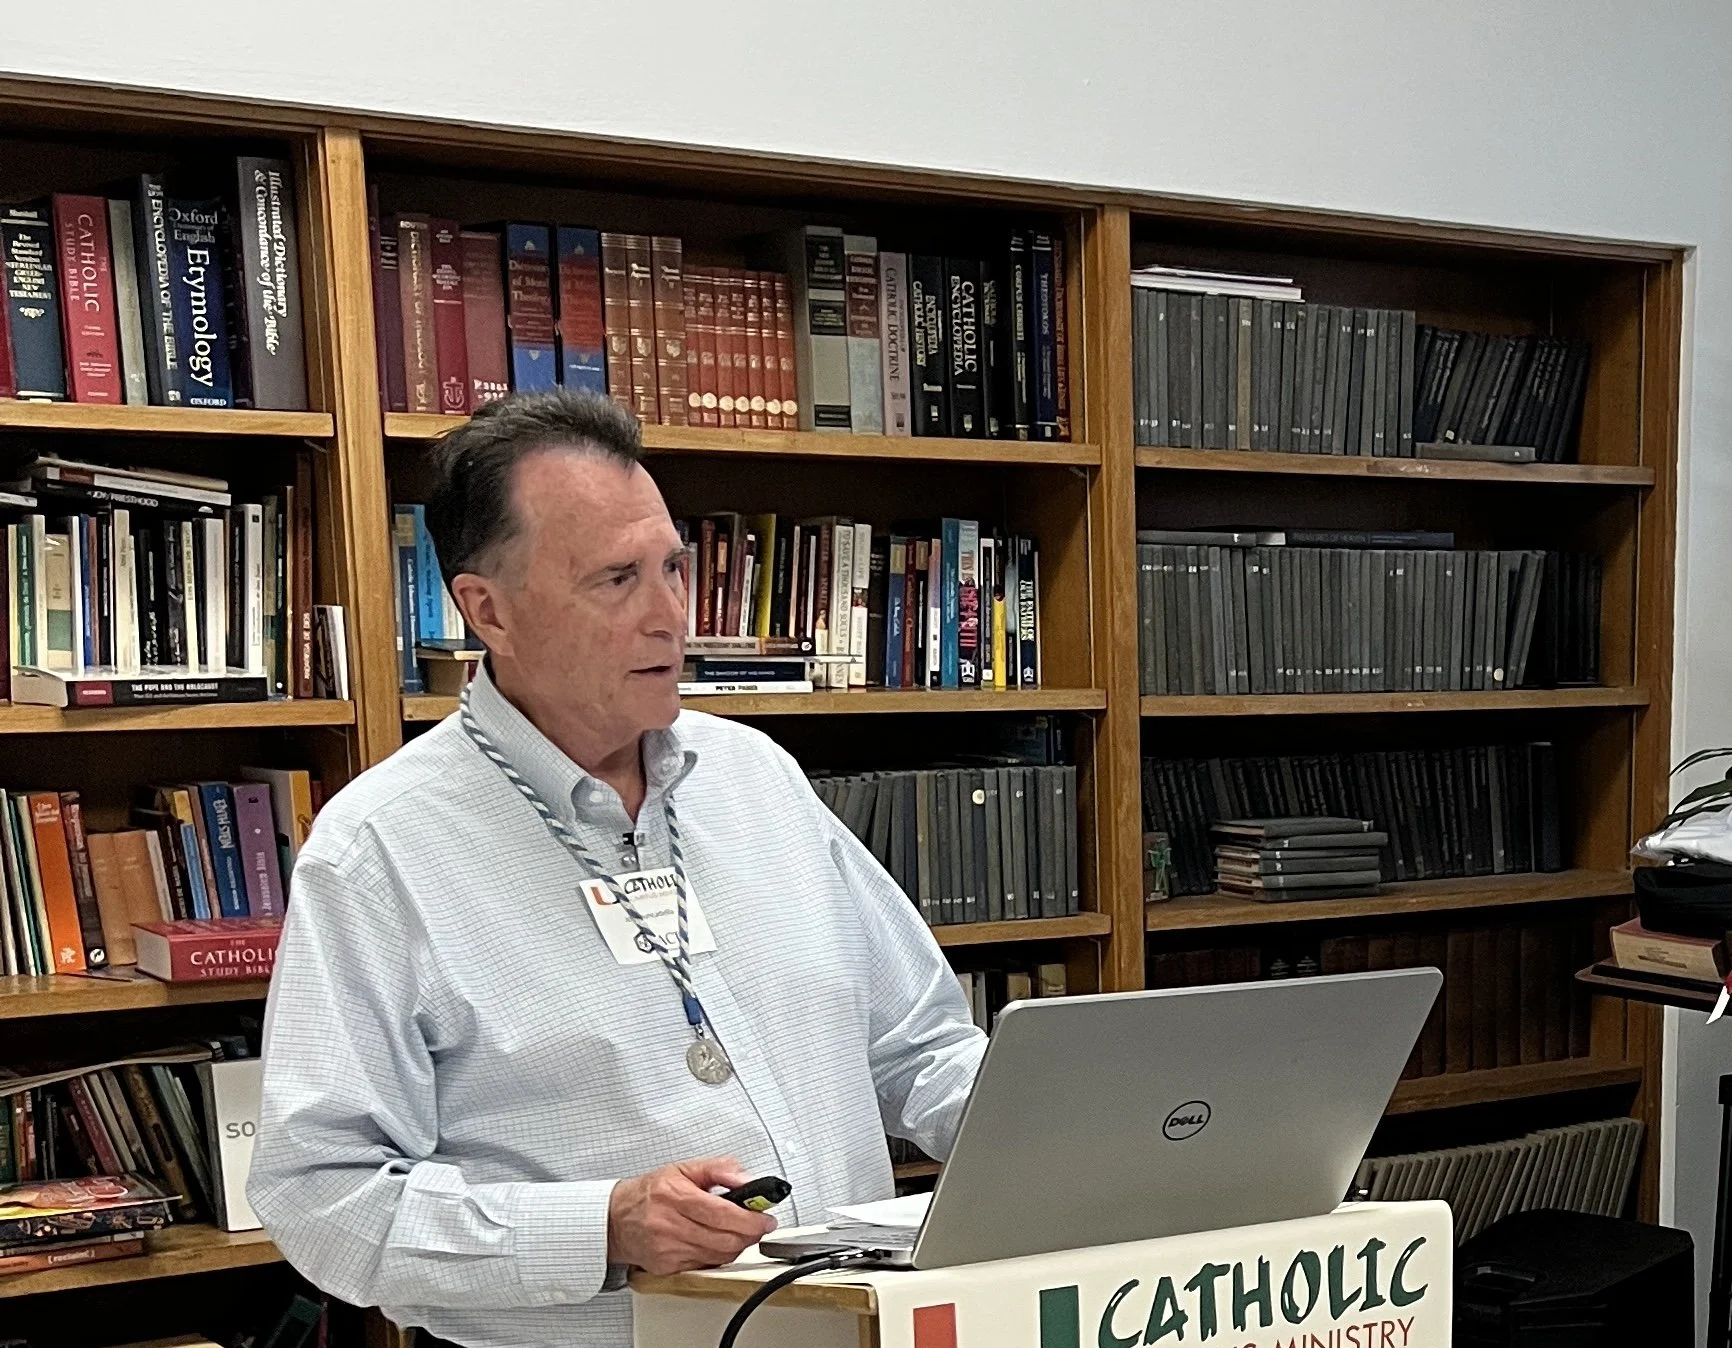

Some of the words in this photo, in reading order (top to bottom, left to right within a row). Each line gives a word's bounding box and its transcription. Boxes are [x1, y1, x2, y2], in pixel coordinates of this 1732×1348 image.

[169, 207, 218, 225] Oxford
[268, 170, 286, 241] Illustrated
[65, 223, 77, 267] STUDY
[152, 199, 170, 290] ENCYCLOPEDIA
[174, 229, 216, 244] English
[255, 186, 273, 272] Concordance
[78, 213, 100, 312] CATHOLIC
[257, 272, 277, 289] of
[274, 241, 288, 317] Dictionary
[68, 268, 80, 302] BIBLE
[160, 290, 172, 308] OF
[262, 289, 277, 315] the
[885, 267, 898, 320] CATHOLIC
[1015, 264, 1023, 302] CORPUS
[162, 310, 174, 335] THE
[182, 248, 218, 388] Etymology
[912, 281, 925, 327] CATHOLIC
[1040, 273, 1050, 335] THEOTOKOS
[264, 316, 281, 356] Bible
[925, 295, 938, 355] ENCYCLOPEDIA
[950, 275, 965, 376] ENCYCLOPEDIA
[960, 281, 977, 373] CATHOLIC
[164, 335, 177, 370] BIBLE
[887, 323, 900, 381] DOCTRINE
[916, 328, 927, 367] HISTORY
[190, 397, 227, 407] OXFORD
[841, 541, 851, 562] SAVE
[839, 569, 849, 612] THOUSAND
[1019, 600, 1027, 641] FATHERS
[1025, 600, 1034, 627] FAITH
[212, 798, 231, 825] EDITH
[624, 875, 679, 894] CATHOLI
[190, 947, 273, 965] CATHOLI
[200, 966, 239, 977] STUDY
[245, 964, 271, 975] BIBL
[226, 1121, 256, 1139] SO
[1168, 1114, 1204, 1127] DELL
